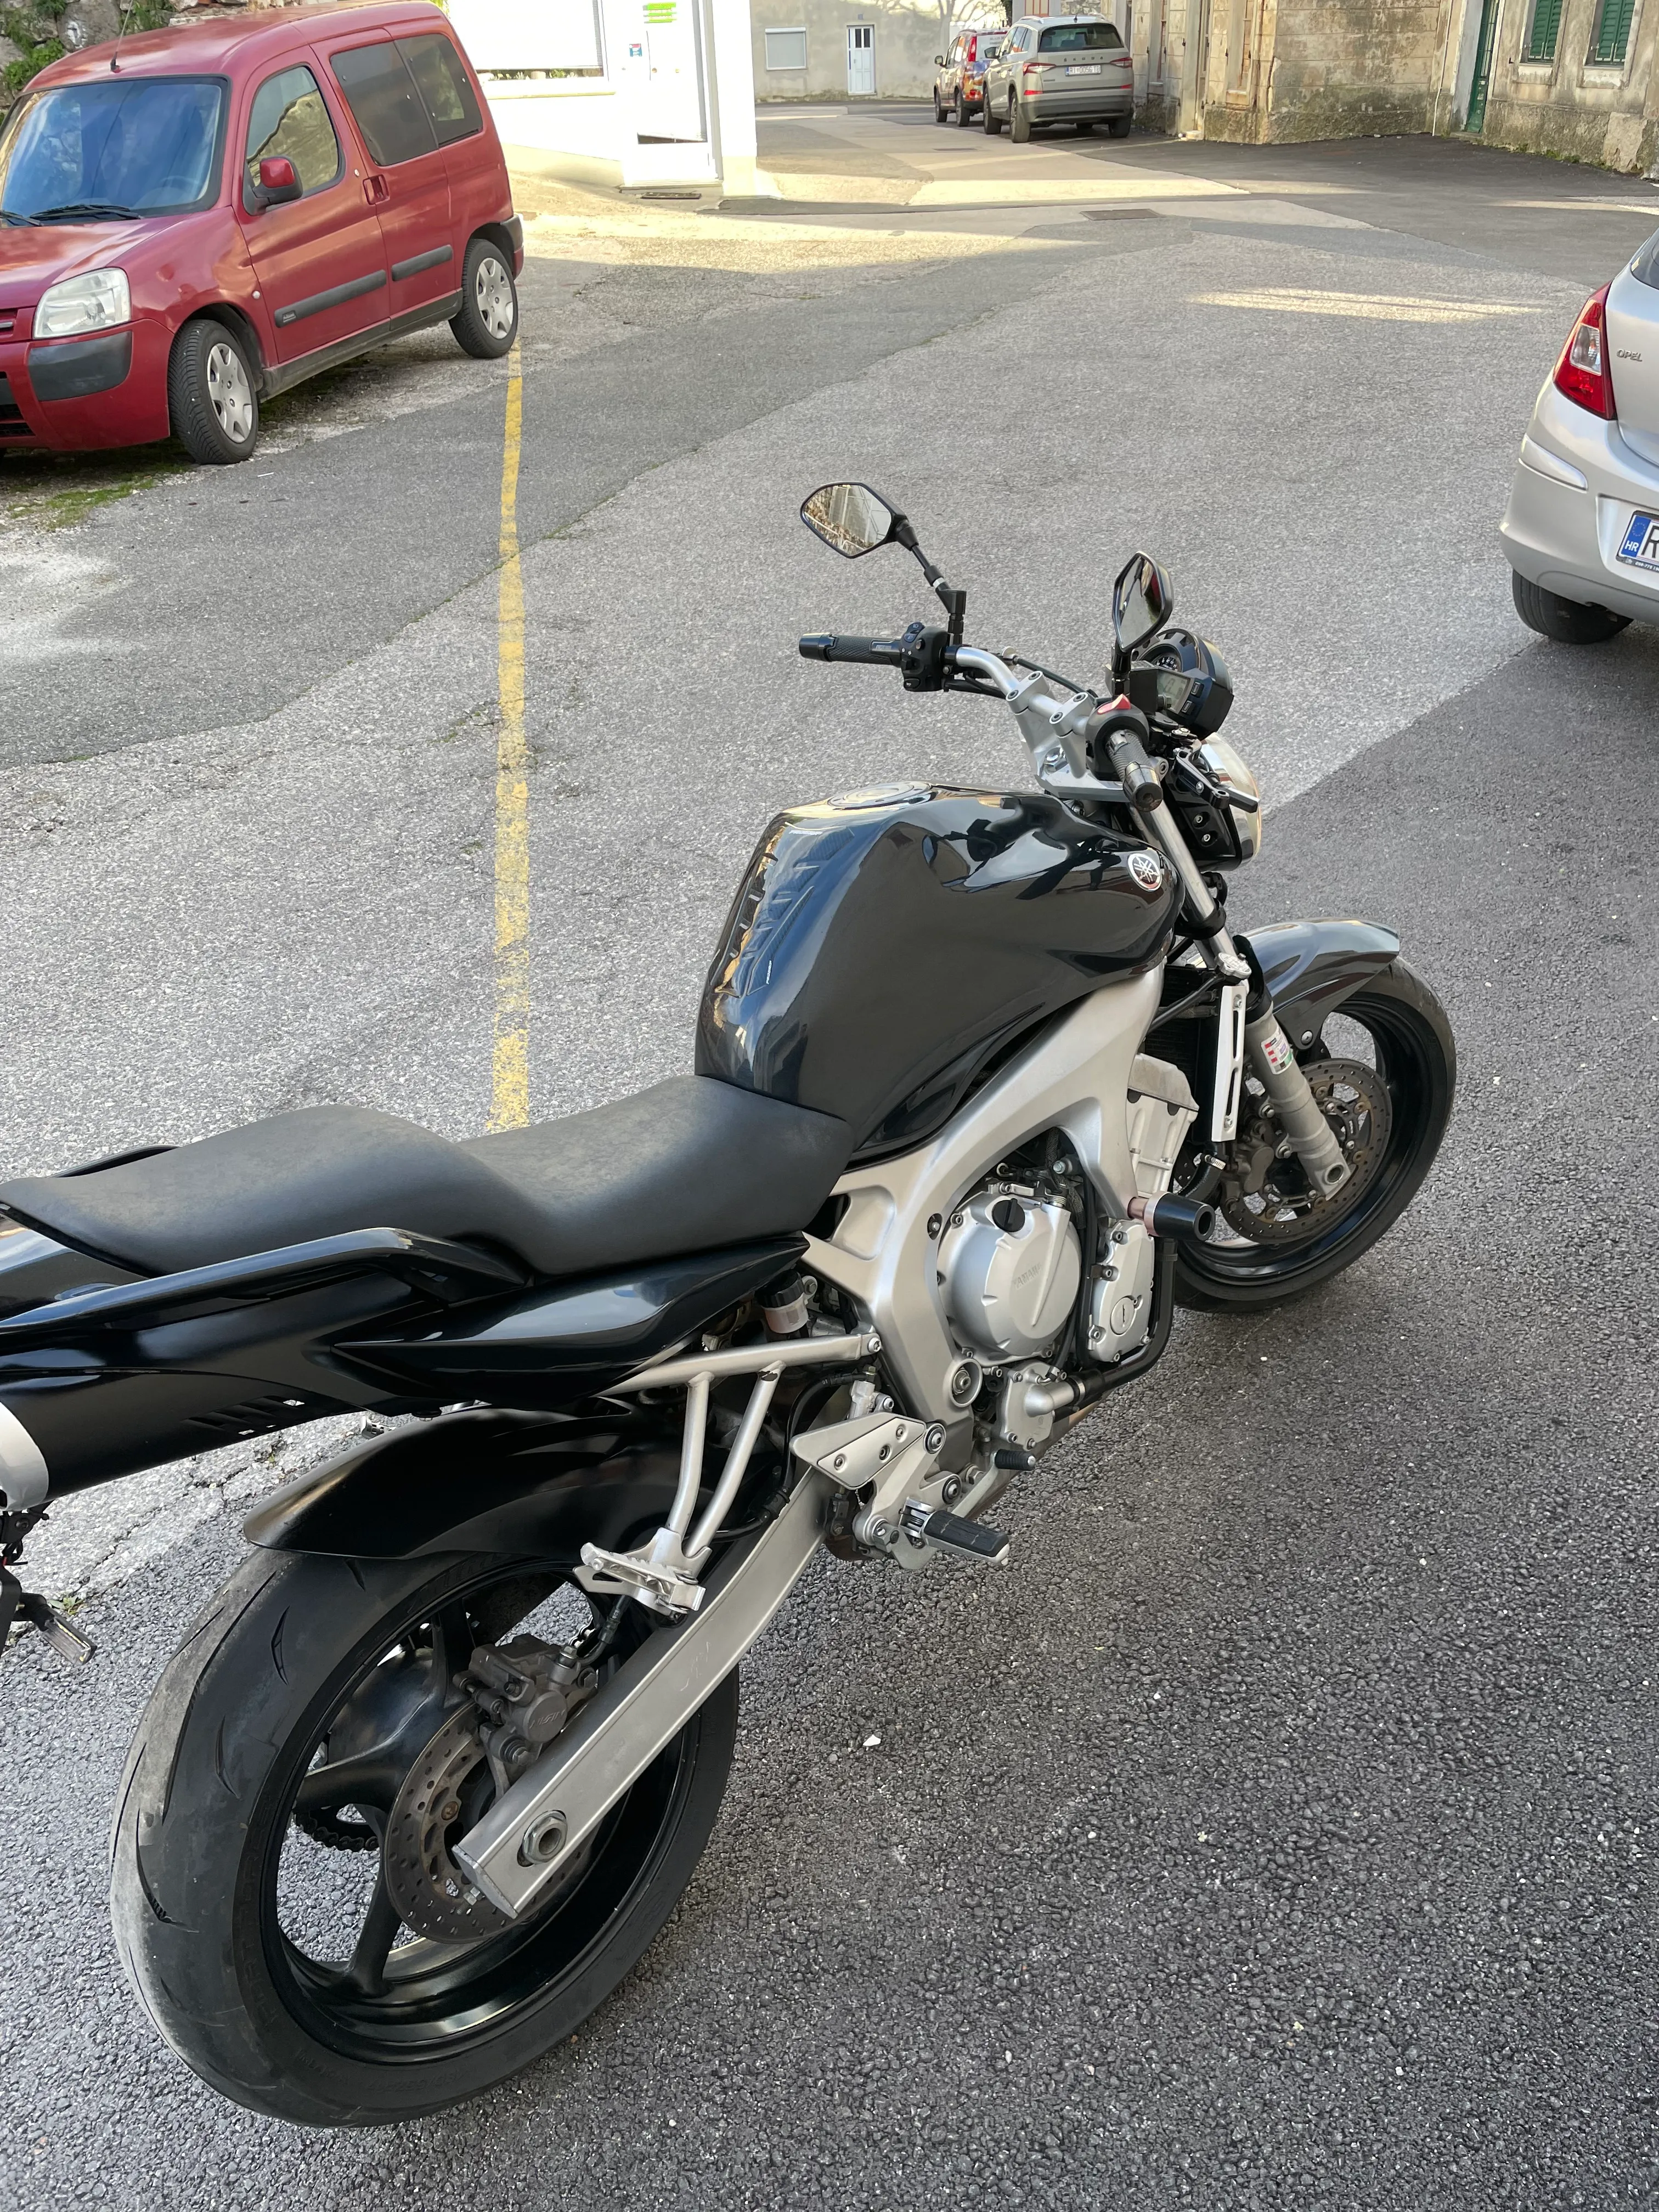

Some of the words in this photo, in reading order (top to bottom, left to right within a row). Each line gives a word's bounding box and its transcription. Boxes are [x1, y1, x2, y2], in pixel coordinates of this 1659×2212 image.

[1616, 348, 1643, 362] OPEL
[1624, 540, 1639, 552] HR
[1012, 1261, 1043, 1290] YAMAHA
